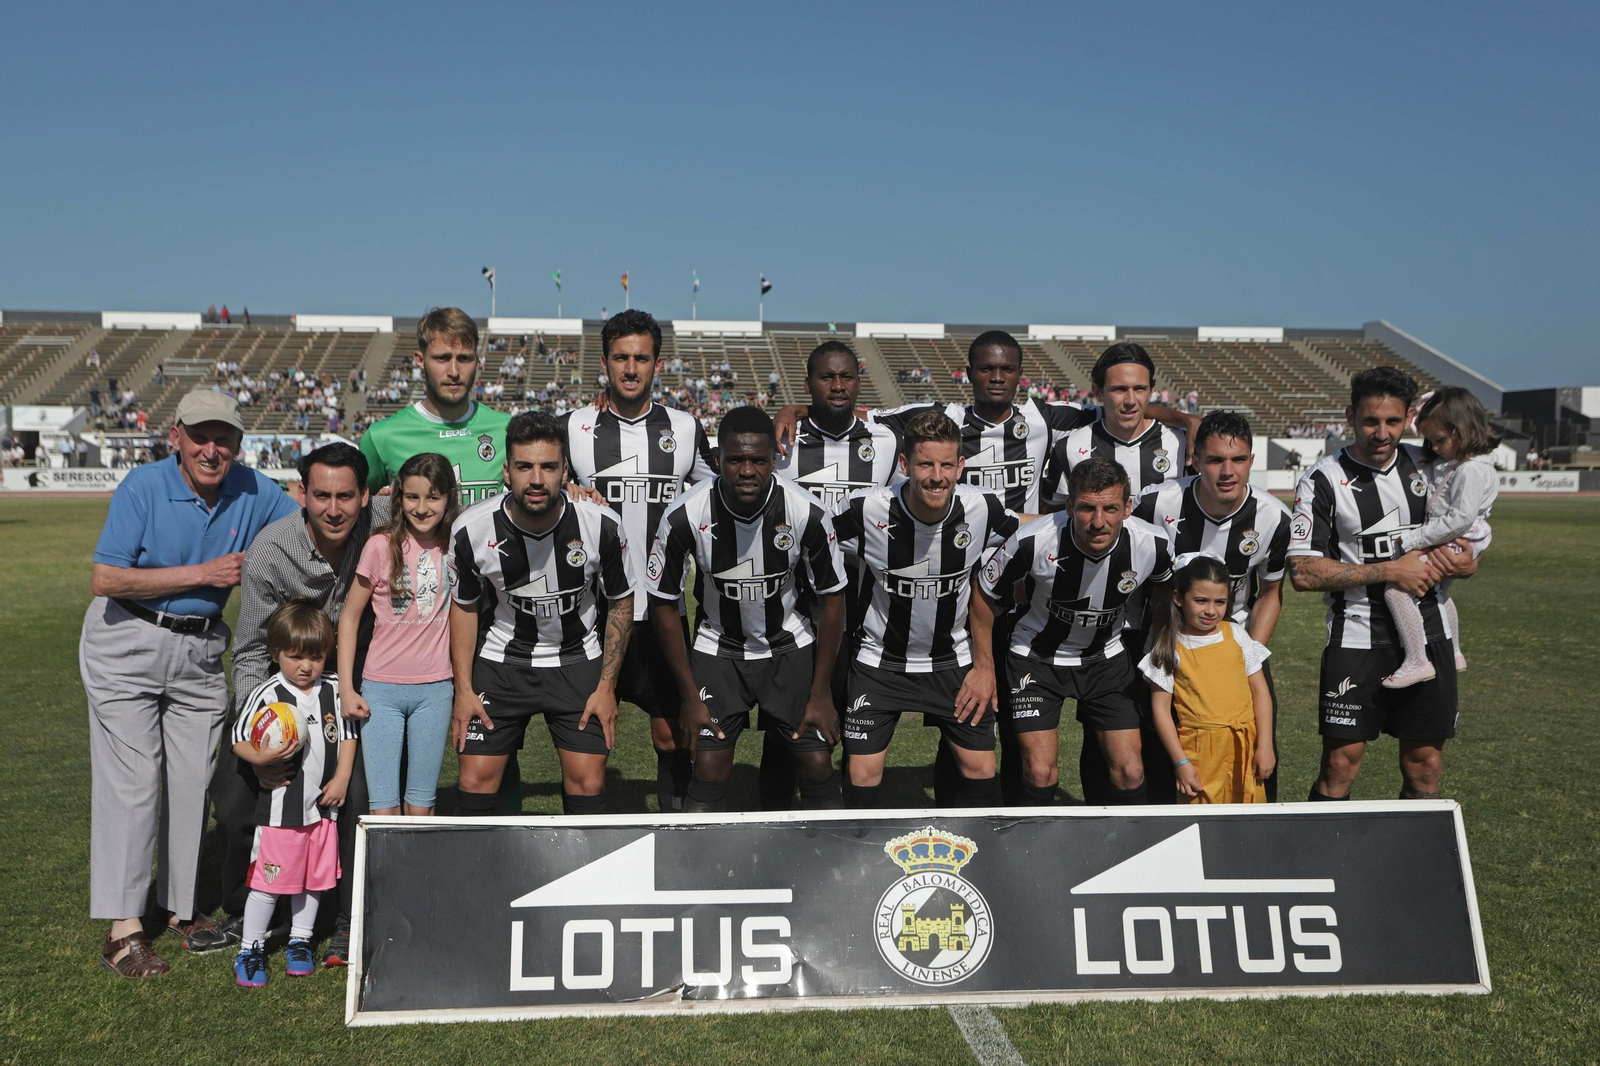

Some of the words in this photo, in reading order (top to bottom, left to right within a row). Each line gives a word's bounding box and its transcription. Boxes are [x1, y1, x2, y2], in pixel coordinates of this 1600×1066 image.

[439, 429, 472, 438] LEGEA
[52, 471, 119, 482] SERESCOL
[966, 465, 1035, 491] OTUS
[883, 571, 970, 600] LOTUS
[507, 584, 589, 617] LOTUS
[1324, 715, 1356, 726] LEGEA
[880, 904, 895, 939] REAL
[902, 874, 988, 937] BALOMPEDICA
[510, 916, 793, 991] LOTUS
[1073, 905, 1343, 975] LOTUS
[903, 961, 970, 981] LINENSE
